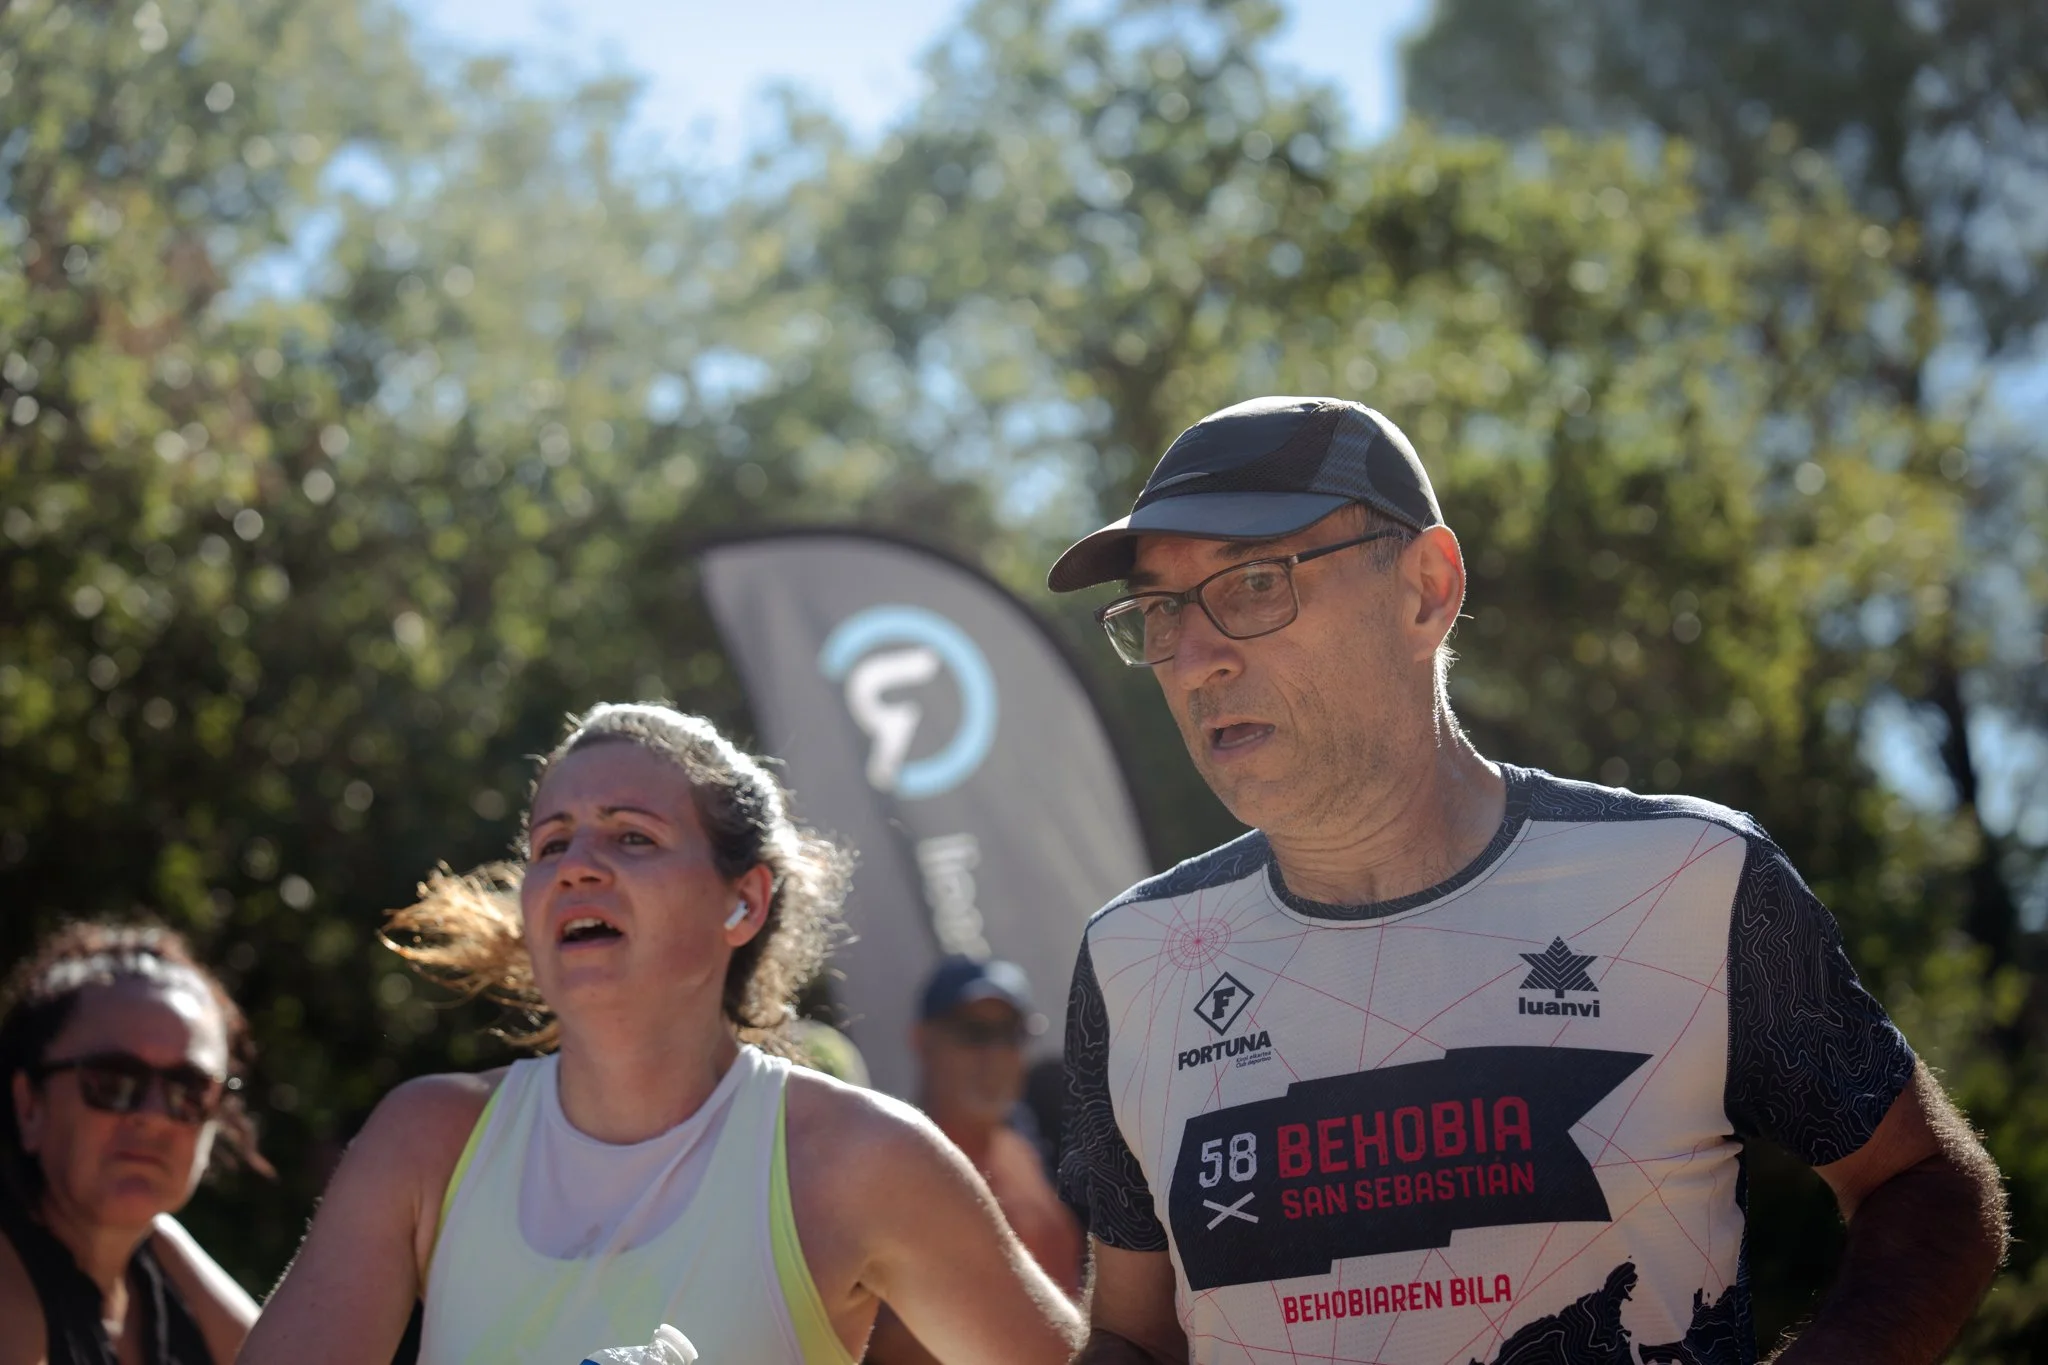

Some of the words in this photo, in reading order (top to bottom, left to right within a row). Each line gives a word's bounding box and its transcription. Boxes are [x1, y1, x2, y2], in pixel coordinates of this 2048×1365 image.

[1212, 986, 1236, 1020] F
[1518, 996, 1600, 1018] luanvi
[1178, 1030, 1272, 1071] FORTUNA
[1199, 1132, 1257, 1188] 58
[1277, 1096, 1532, 1179] BEHOBIA
[1281, 1182, 1348, 1220] SAN
[1354, 1156, 1535, 1211] SEBASTIÁN
[1283, 1279, 1443, 1324] BEHOBIAREN
[1450, 1274, 1512, 1307] BILA
